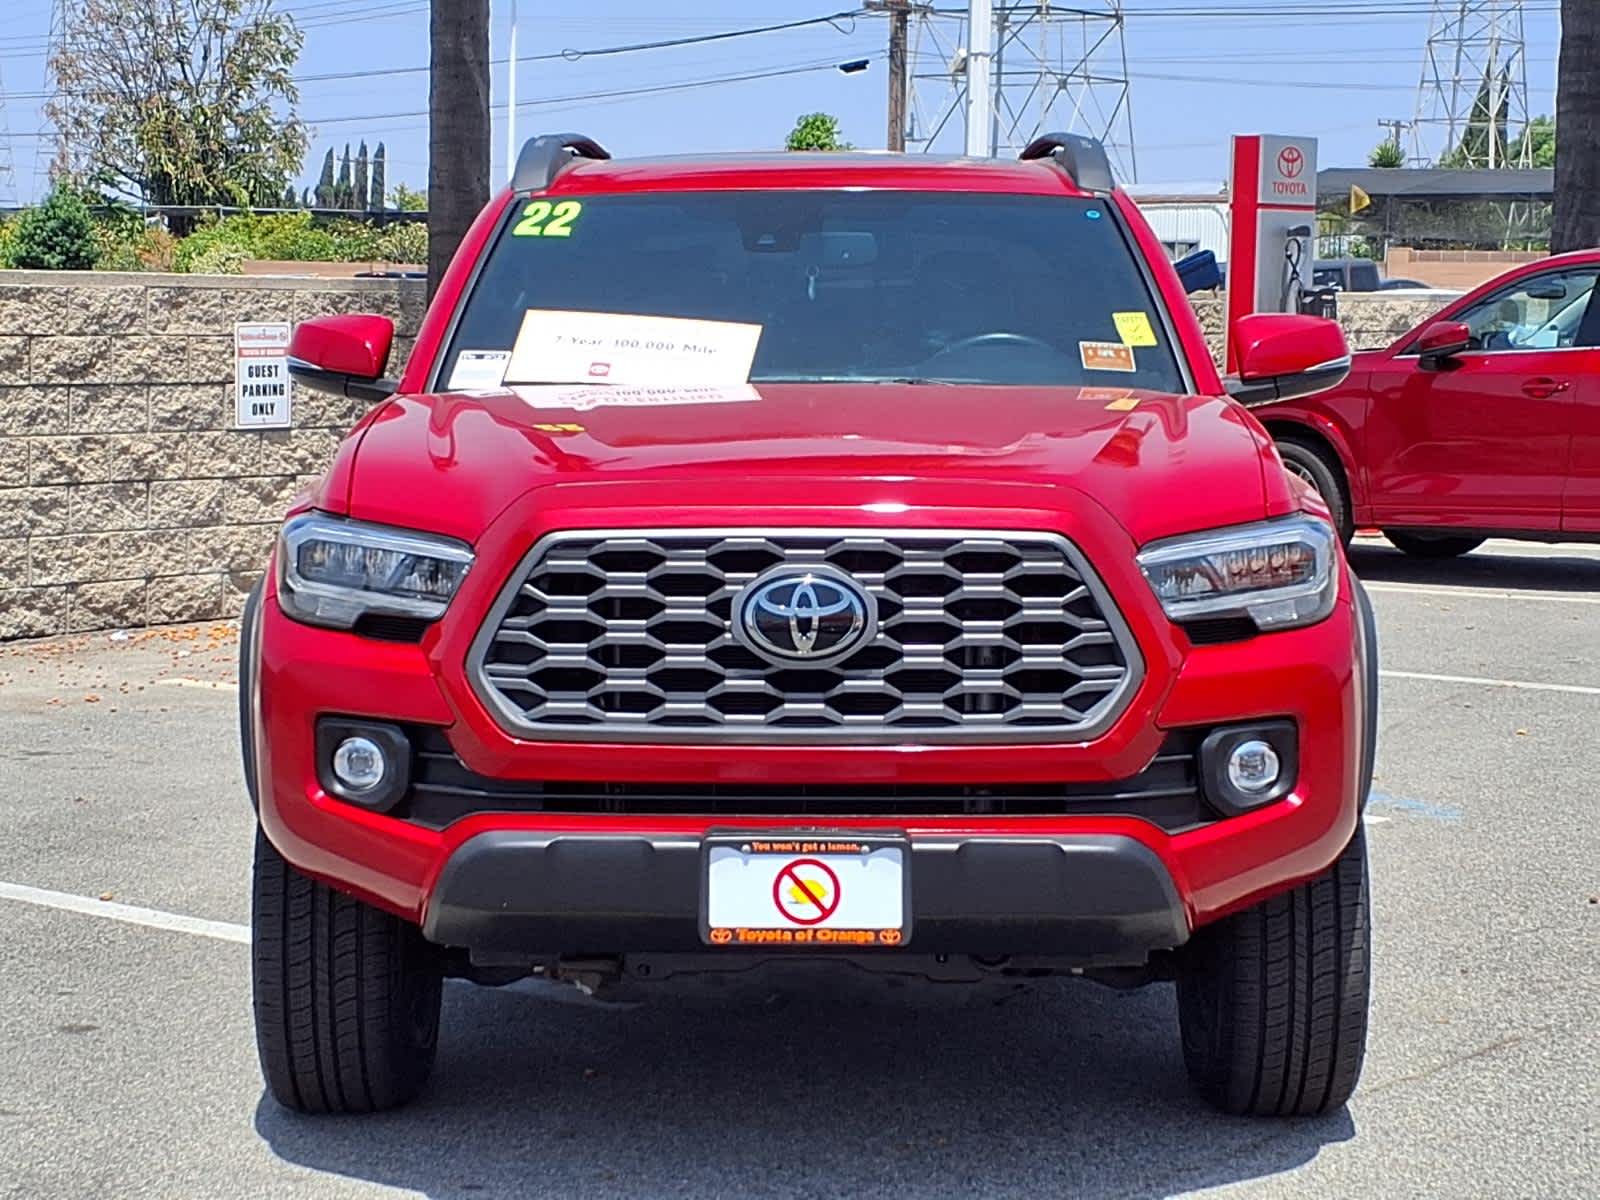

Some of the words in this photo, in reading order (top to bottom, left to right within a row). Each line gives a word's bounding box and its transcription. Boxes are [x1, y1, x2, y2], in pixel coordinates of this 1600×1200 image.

[1272, 181, 1307, 194] TOYOTA
[513, 201, 582, 237] 22
[248, 365, 279, 378] GUEST
[242, 384, 285, 397] PARKING
[252, 403, 275, 416] ONLY
[751, 841, 770, 852] You
[772, 841, 800, 852] won't
[802, 842, 818, 853] get
[819, 843, 826, 852] a
[737, 928, 793, 944] Toyota
[795, 928, 814, 943] of
[816, 928, 876, 944] Orange
